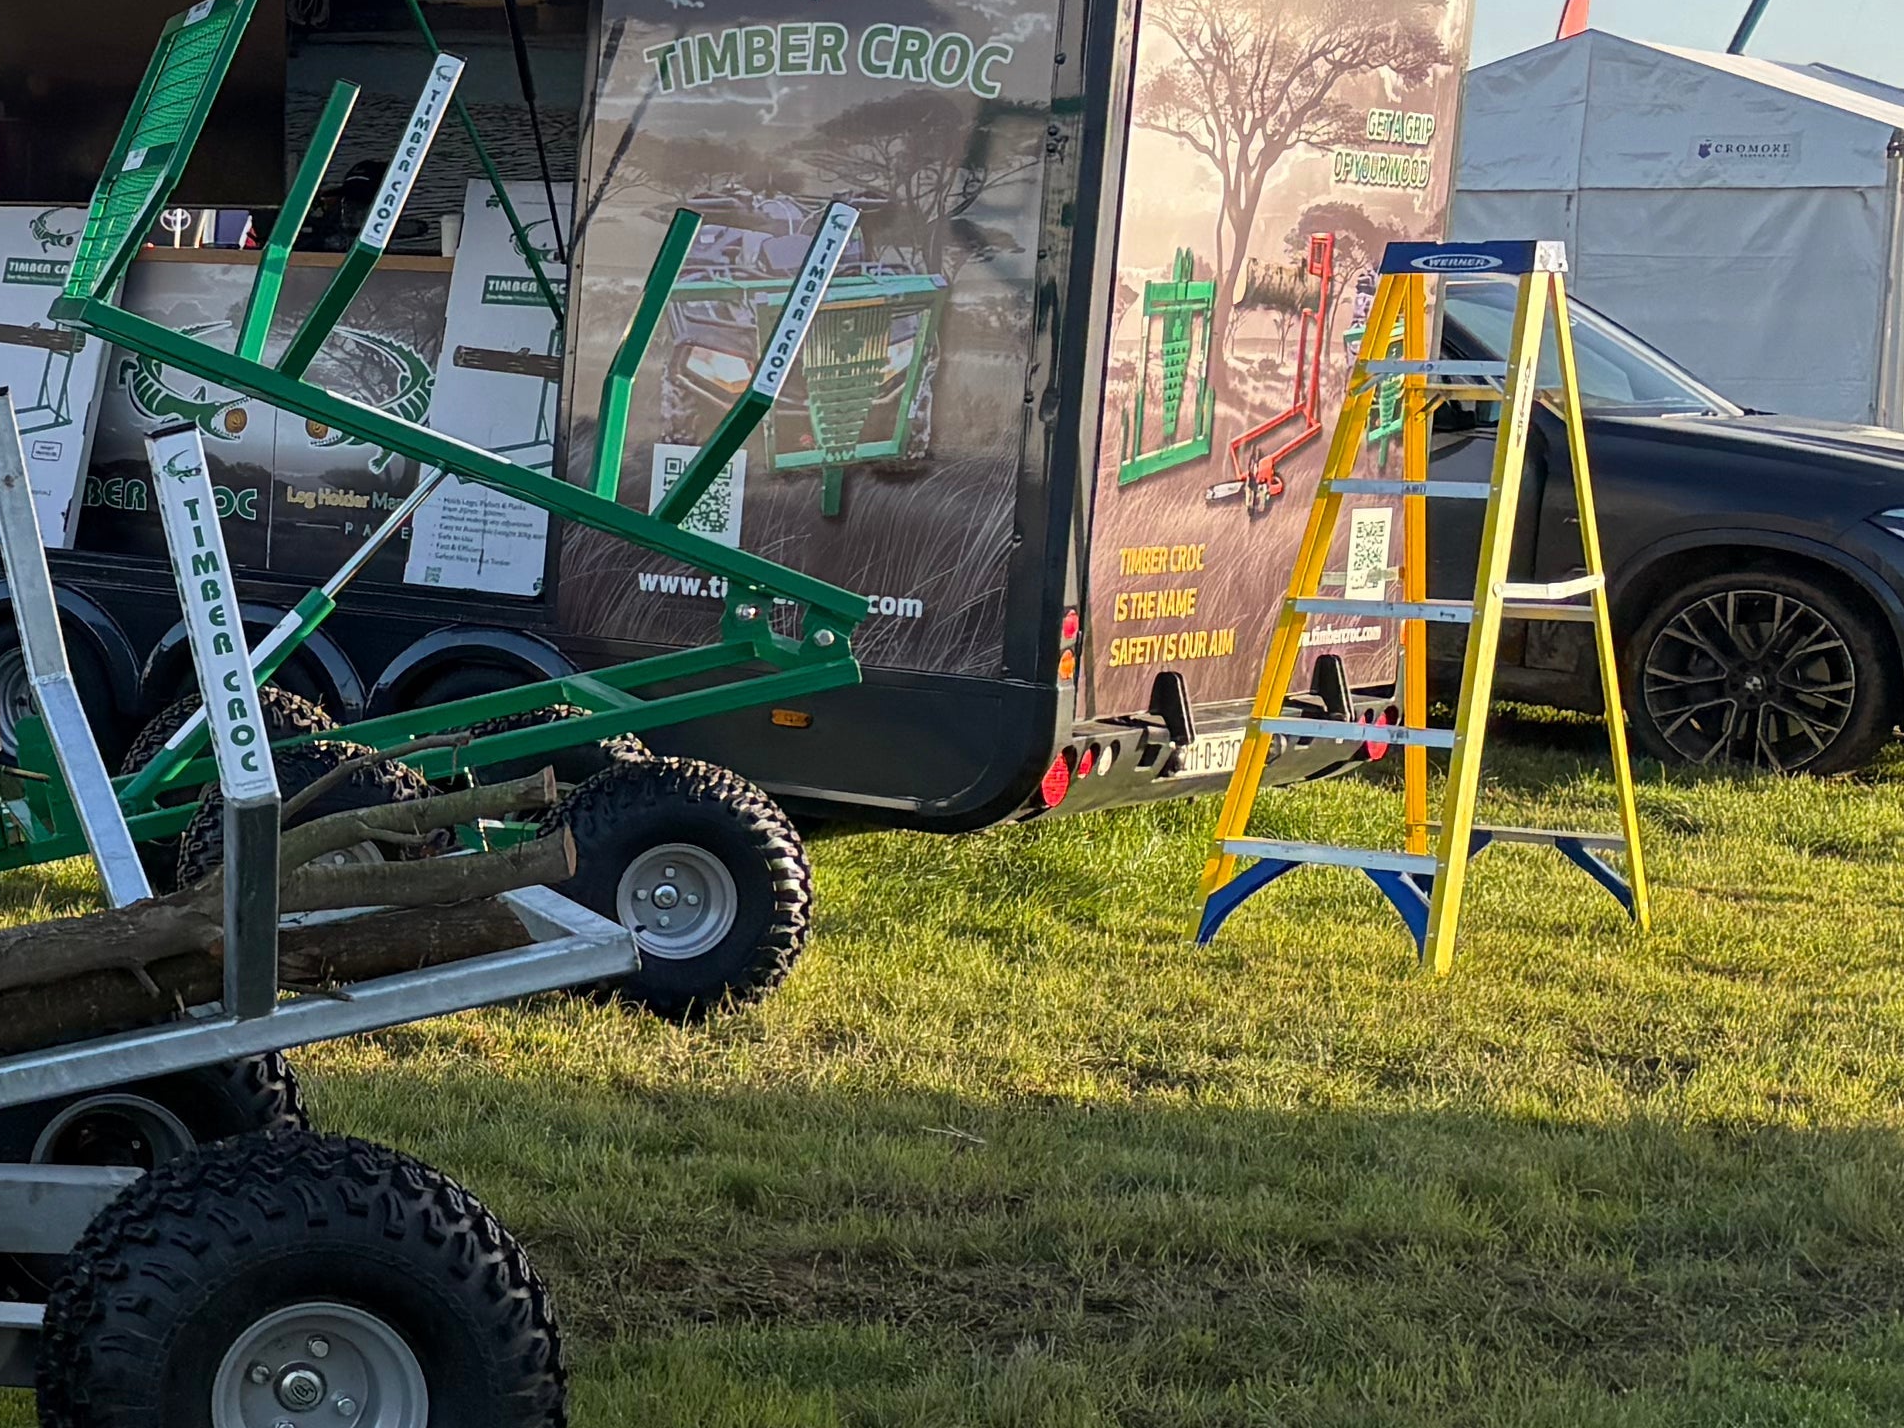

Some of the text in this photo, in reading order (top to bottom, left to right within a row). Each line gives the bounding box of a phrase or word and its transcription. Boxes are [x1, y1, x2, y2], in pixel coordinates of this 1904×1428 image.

[644, 22, 1014, 99] TIMBER CROC
[398, 89, 441, 173] TIMBER
[1367, 109, 1435, 145] GET A GRIP
[1333, 150, 1432, 189] OF YOUR WOOD
[373, 180, 402, 234] CROC
[8, 261, 52, 274] TIMBER
[792, 237, 837, 321] TIMBER
[1426, 257, 1488, 268] WERNER
[487, 279, 538, 294] TIMBER
[766, 329, 796, 383] CROC
[286, 486, 317, 509] Log
[319, 486, 370, 510] Holder
[1119, 543, 1206, 576] TIMBER CROC
[1113, 587, 1198, 622] IS THE NAME
[183, 497, 235, 656] TIMBER
[223, 669, 260, 772] CROC
[1109, 627, 1235, 668] SAFETY IS OUR AIM
